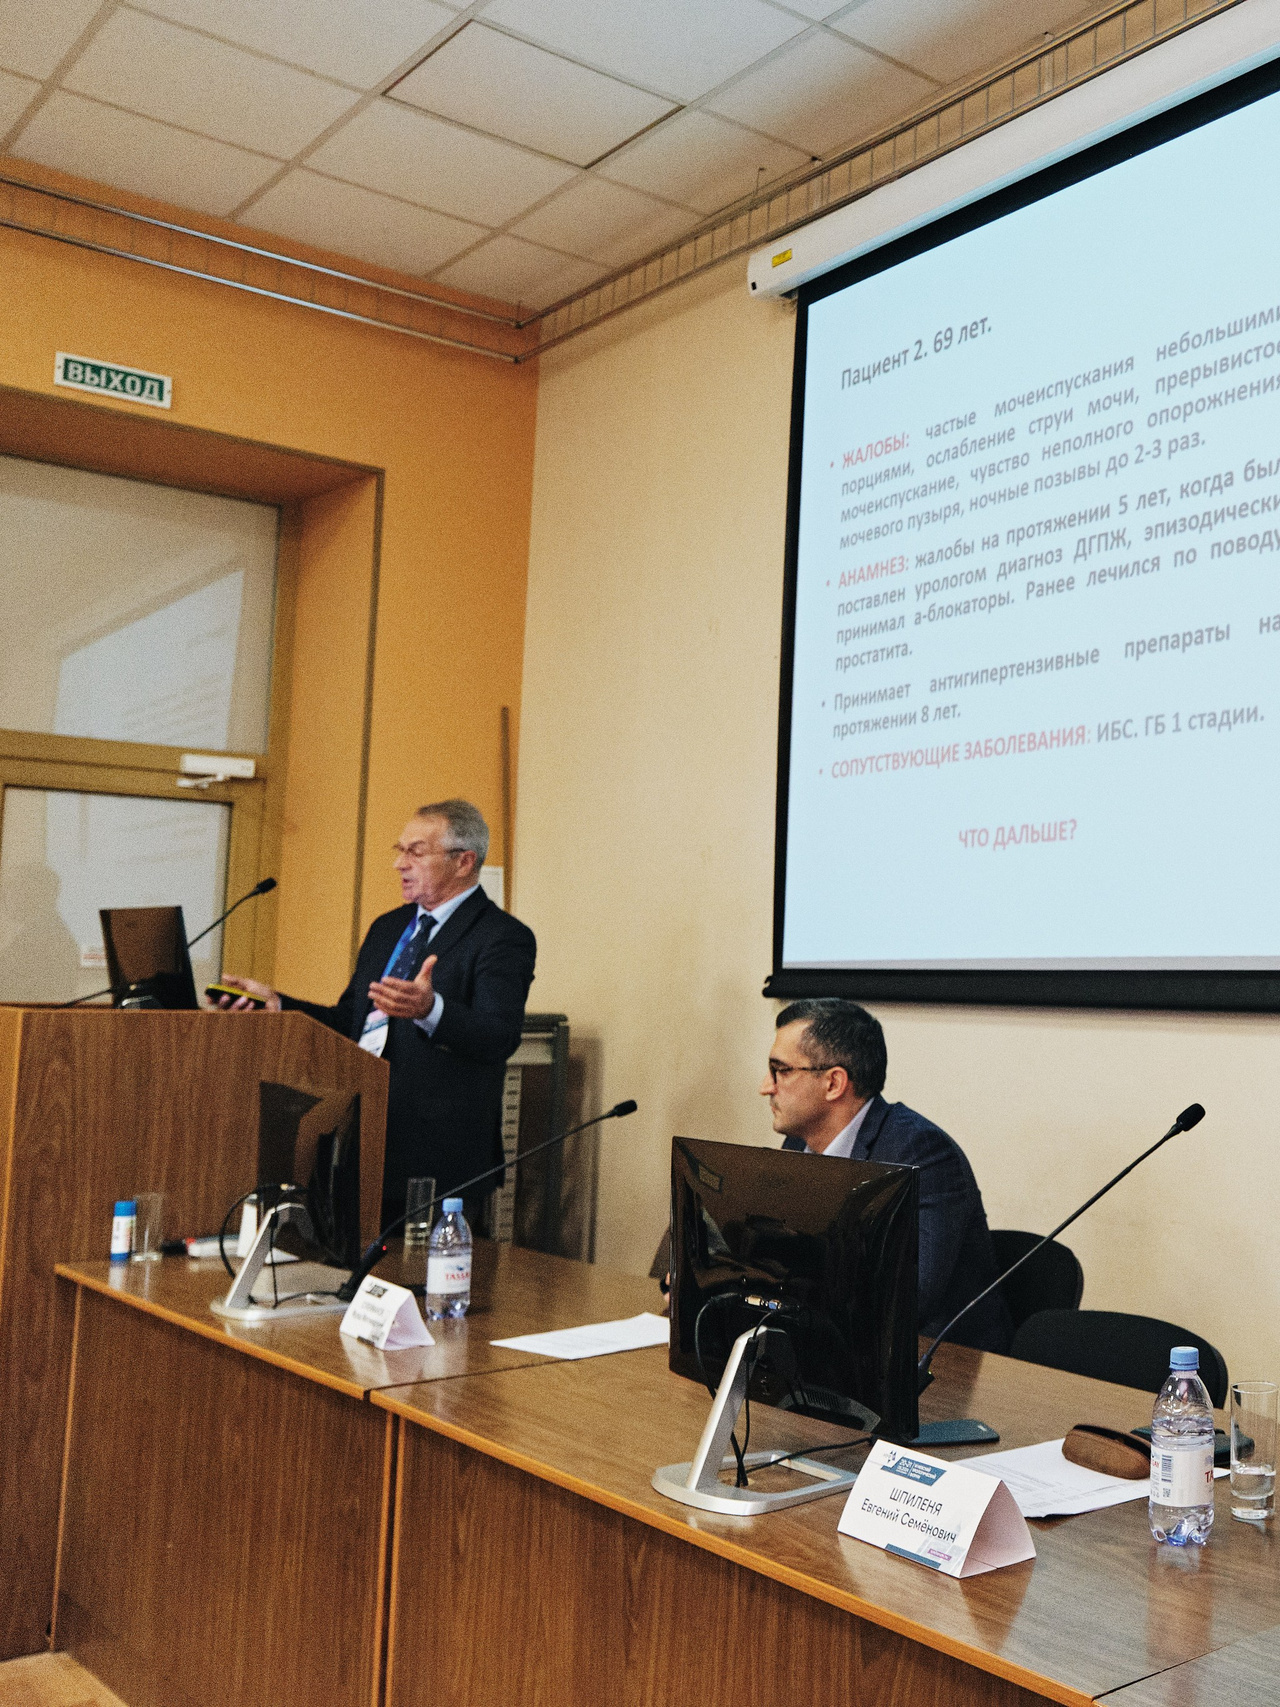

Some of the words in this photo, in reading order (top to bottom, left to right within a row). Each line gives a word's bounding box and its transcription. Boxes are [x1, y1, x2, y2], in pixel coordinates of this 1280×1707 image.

[68, 362, 159, 400] ВЫХОД
[841, 348, 910, 390] Пациент
[913, 339, 928, 361] 2.
[933, 326, 954, 353] 69
[958, 316, 992, 345] лет.
[841, 461, 915, 497] порциями,
[926, 426, 1016, 468] ослабление
[1028, 407, 1074, 437] струи
[1087, 386, 1140, 417] мочи,
[842, 433, 910, 469] ЖАЛОБЫ:
[925, 411, 977, 439] частые
[994, 355, 1135, 418] мочеиспускания
[839, 519, 903, 549] мочевого
[907, 501, 965, 534] пузыря,
[969, 481, 1029, 513] ночные
[1034, 459, 1101, 494] позывы
[1105, 453, 1129, 478] до
[1134, 438, 1162, 465] 2-3
[1168, 431, 1206, 459] раз.
[840, 475, 959, 522] мочеиспускание,
[970, 452, 1030, 484] чувство
[1041, 419, 1134, 461] неполного
[838, 554, 910, 589] АНАМНЕЗ:
[914, 539, 975, 569] жалобы
[981, 533, 999, 552] на
[1006, 502, 1110, 547] протяжении
[1118, 494, 1128, 516] 5
[1136, 487, 1171, 511] лет,
[1180, 470, 1234, 499] когда
[836, 614, 905, 646] принимал
[914, 591, 1015, 626] а-блокаторы.
[1026, 575, 1075, 601] Ранее
[1086, 555, 1161, 587] лечился
[1174, 547, 1197, 568] по
[837, 587, 906, 617] поставлен
[915, 566, 987, 602] урологом
[996, 547, 1063, 582] диагноз
[1073, 527, 1131, 563] ДГПЖ,
[834, 683, 911, 713] Принимает
[929, 648, 1100, 693] антигипертензивные
[1125, 623, 1230, 661] препараты
[835, 642, 913, 673] простатита.
[831, 743, 960, 779] СОПУТСТВУЮЩИЕ
[964, 724, 1092, 761] ЗАБОЛЕВАНИЯ:
[1097, 718, 1138, 743] ИБС.
[1145, 714, 1166, 737] ГБ
[1172, 711, 1182, 733] 1
[1188, 705, 1265, 732] стадии.
[833, 710, 917, 741] протяжении
[921, 705, 929, 723] 8
[933, 703, 961, 721] лет.
[958, 828, 989, 848] ЧТО
[993, 819, 1078, 850] ДАЛЬШЕ?
[861, 1498, 900, 1523] Евгений
[900, 1512, 957, 1543] Семёнович
[889, 1487, 943, 1517] ШПИЛЕНЯ
